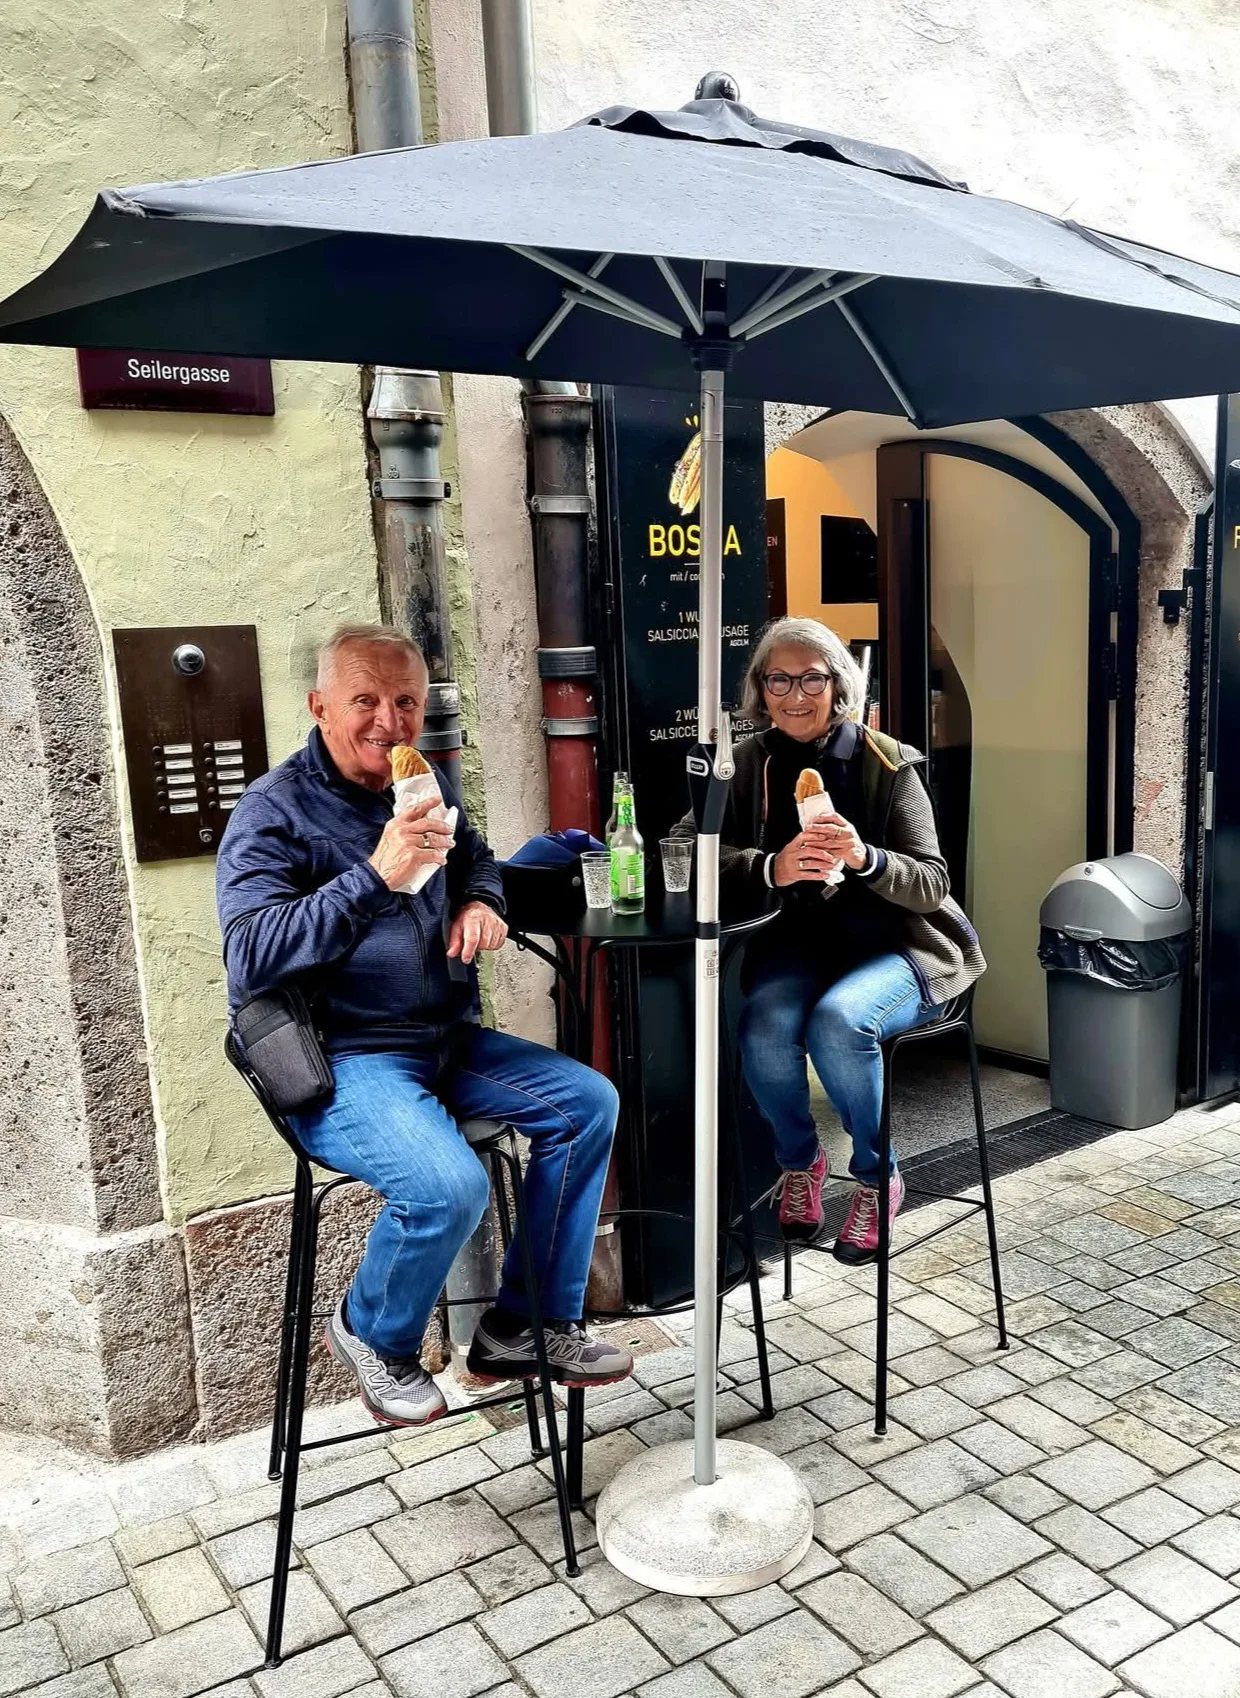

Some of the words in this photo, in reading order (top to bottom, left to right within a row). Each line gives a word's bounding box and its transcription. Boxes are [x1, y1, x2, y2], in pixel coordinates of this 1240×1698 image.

[127, 358, 231, 385] Seilergasse
[648, 524, 742, 557] BOSA
[669, 571, 683, 582] mit
[678, 611, 684, 623] 1
[647, 627, 700, 642] SALSICCIA
[675, 709, 682, 722] 2
[649, 725, 698, 742] SALSICCE
[730, 719, 754, 732] AGES
